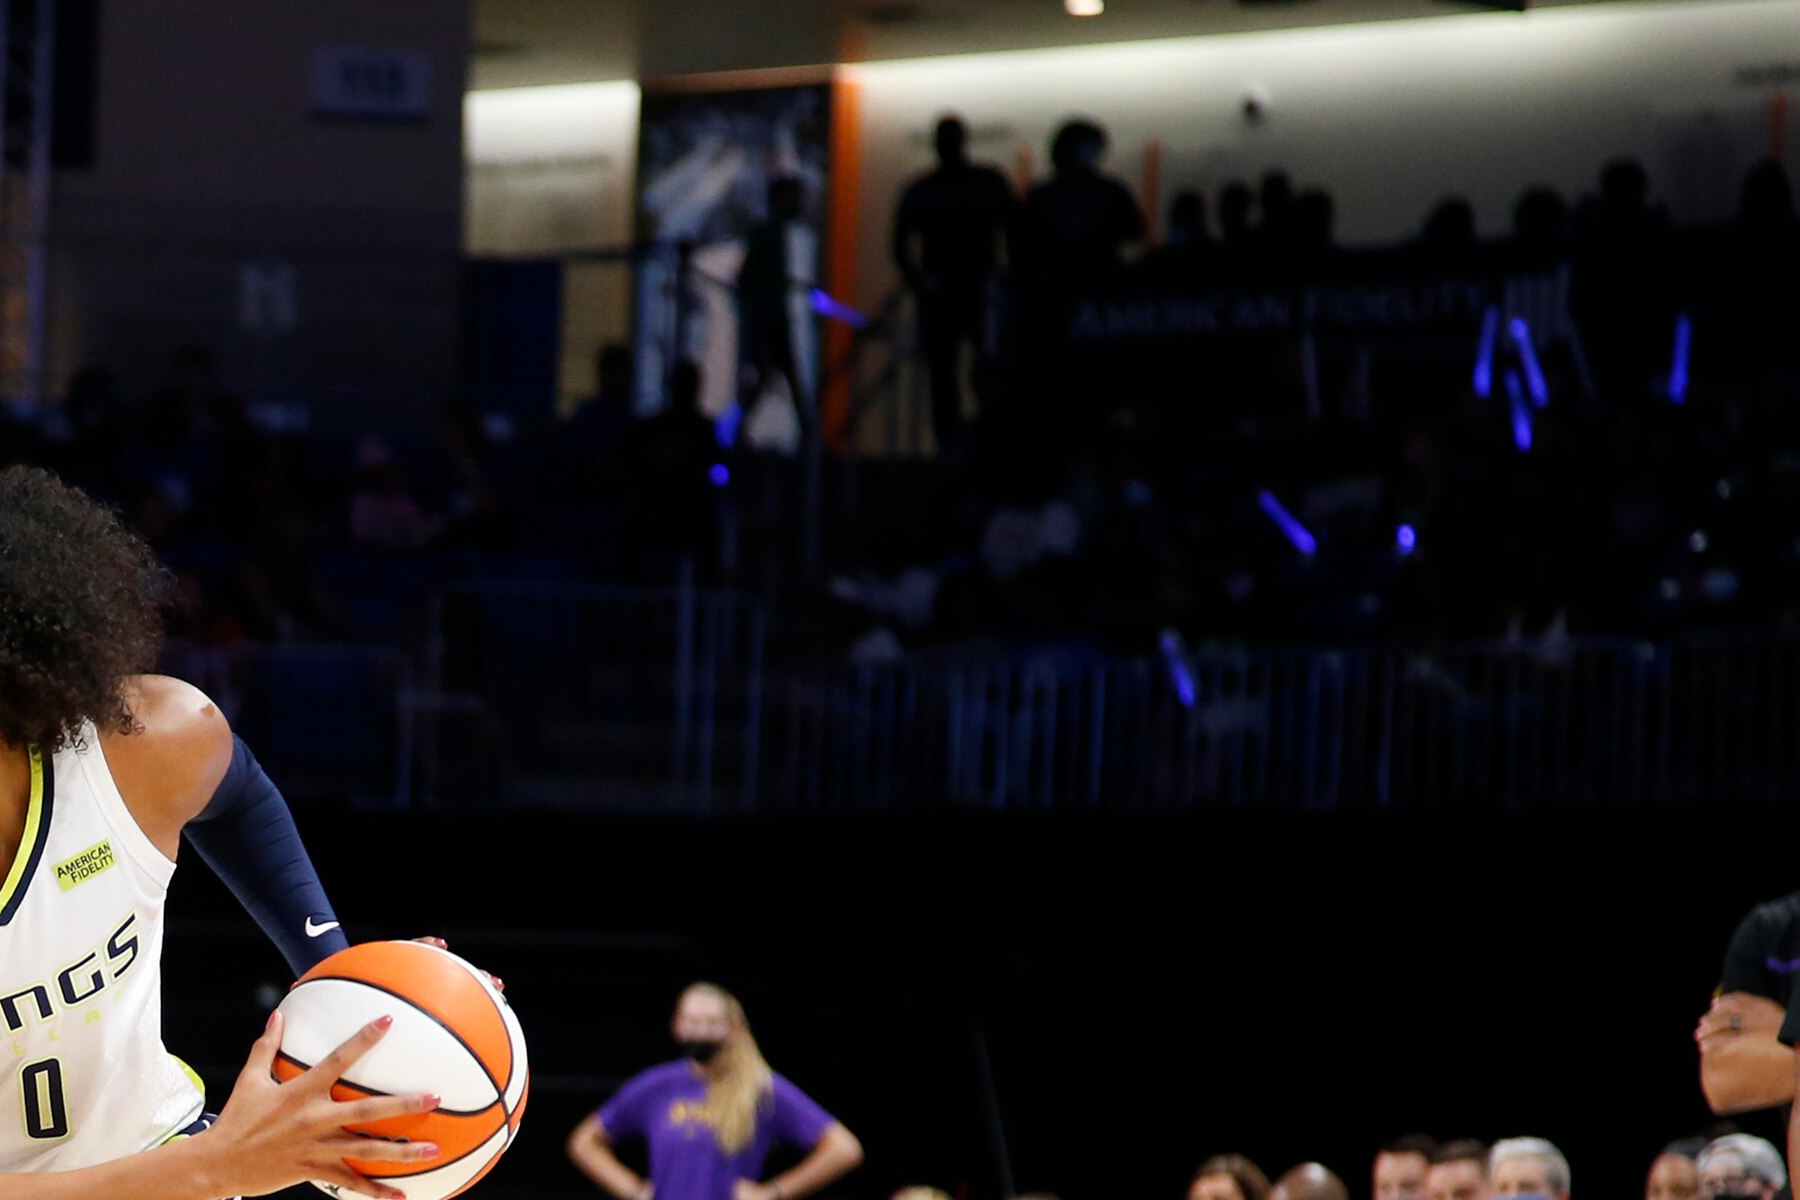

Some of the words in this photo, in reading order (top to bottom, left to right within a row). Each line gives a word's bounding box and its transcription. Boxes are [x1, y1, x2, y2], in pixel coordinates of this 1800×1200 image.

[1070, 293, 1292, 338] AMERICAN
[57, 842, 111, 879] AMERICAN
[70, 852, 114, 883] FIDELITY
[21, 1056, 68, 1139] 0
